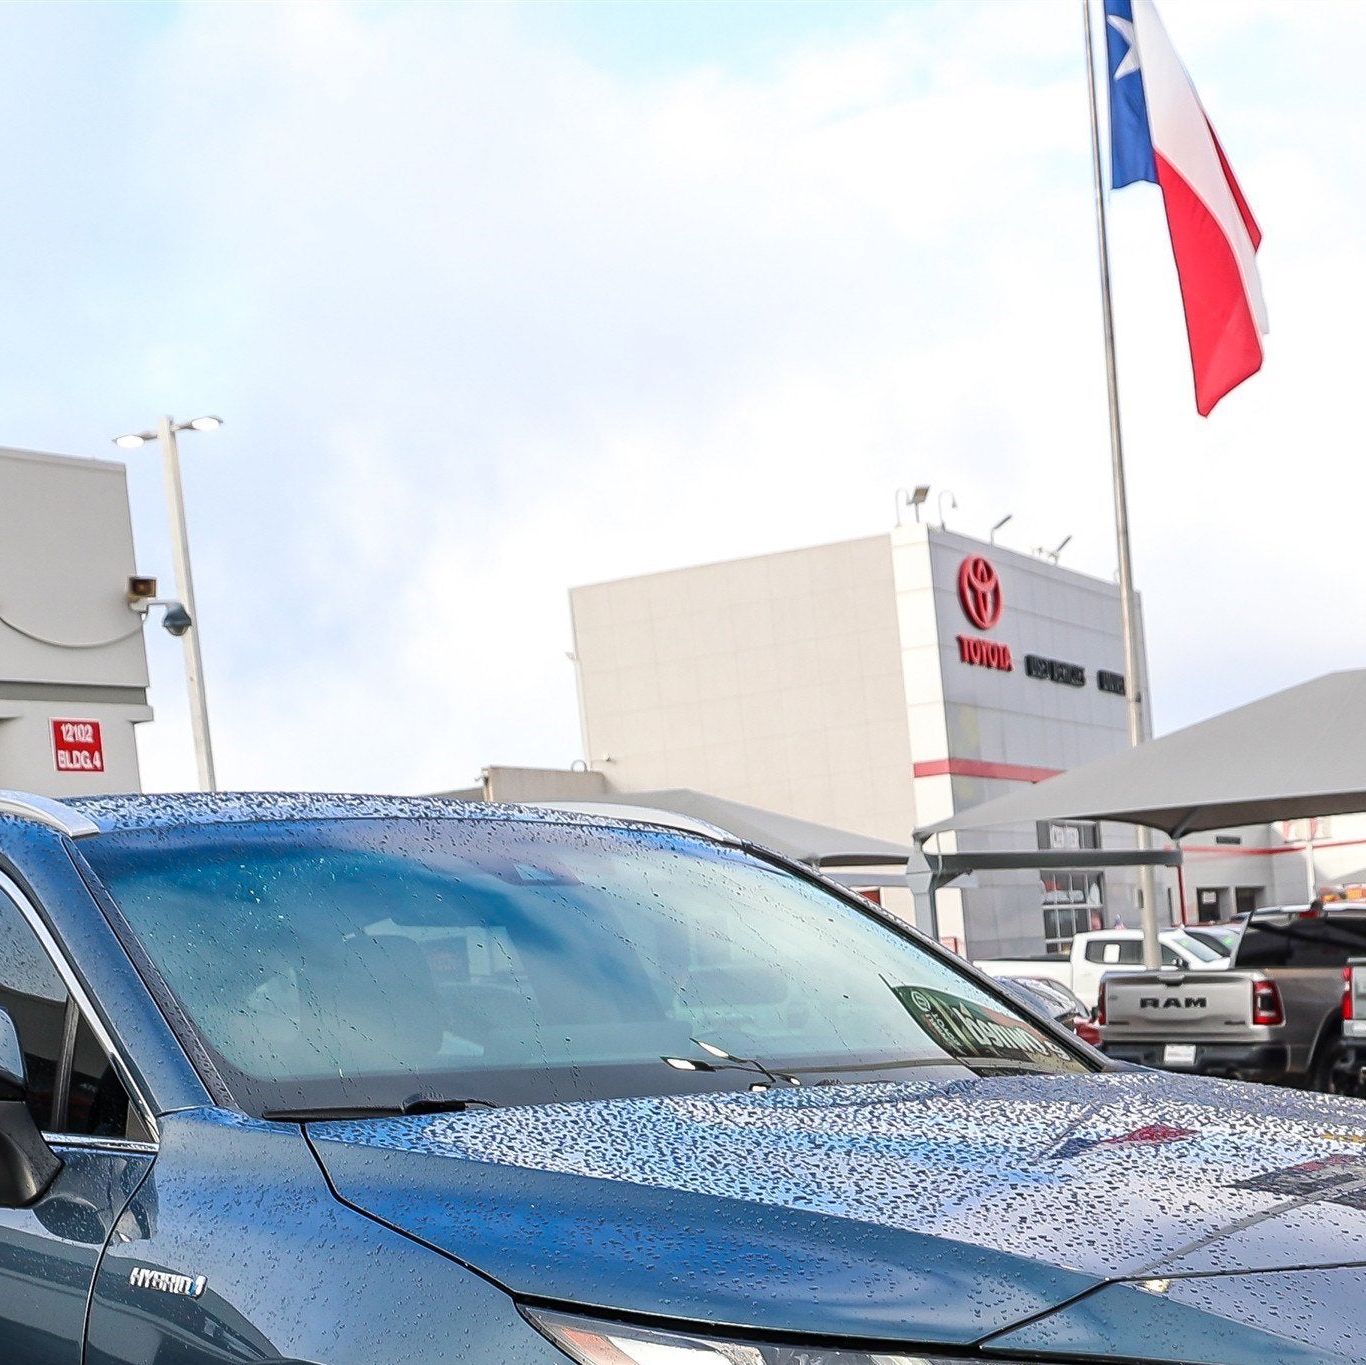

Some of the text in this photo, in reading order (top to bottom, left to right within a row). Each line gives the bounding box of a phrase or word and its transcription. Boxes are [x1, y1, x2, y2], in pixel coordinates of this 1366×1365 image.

[61, 723, 94, 743] 12102
[1140, 997, 1208, 1008] RAM
[129, 1267, 193, 1296] HYBRID
